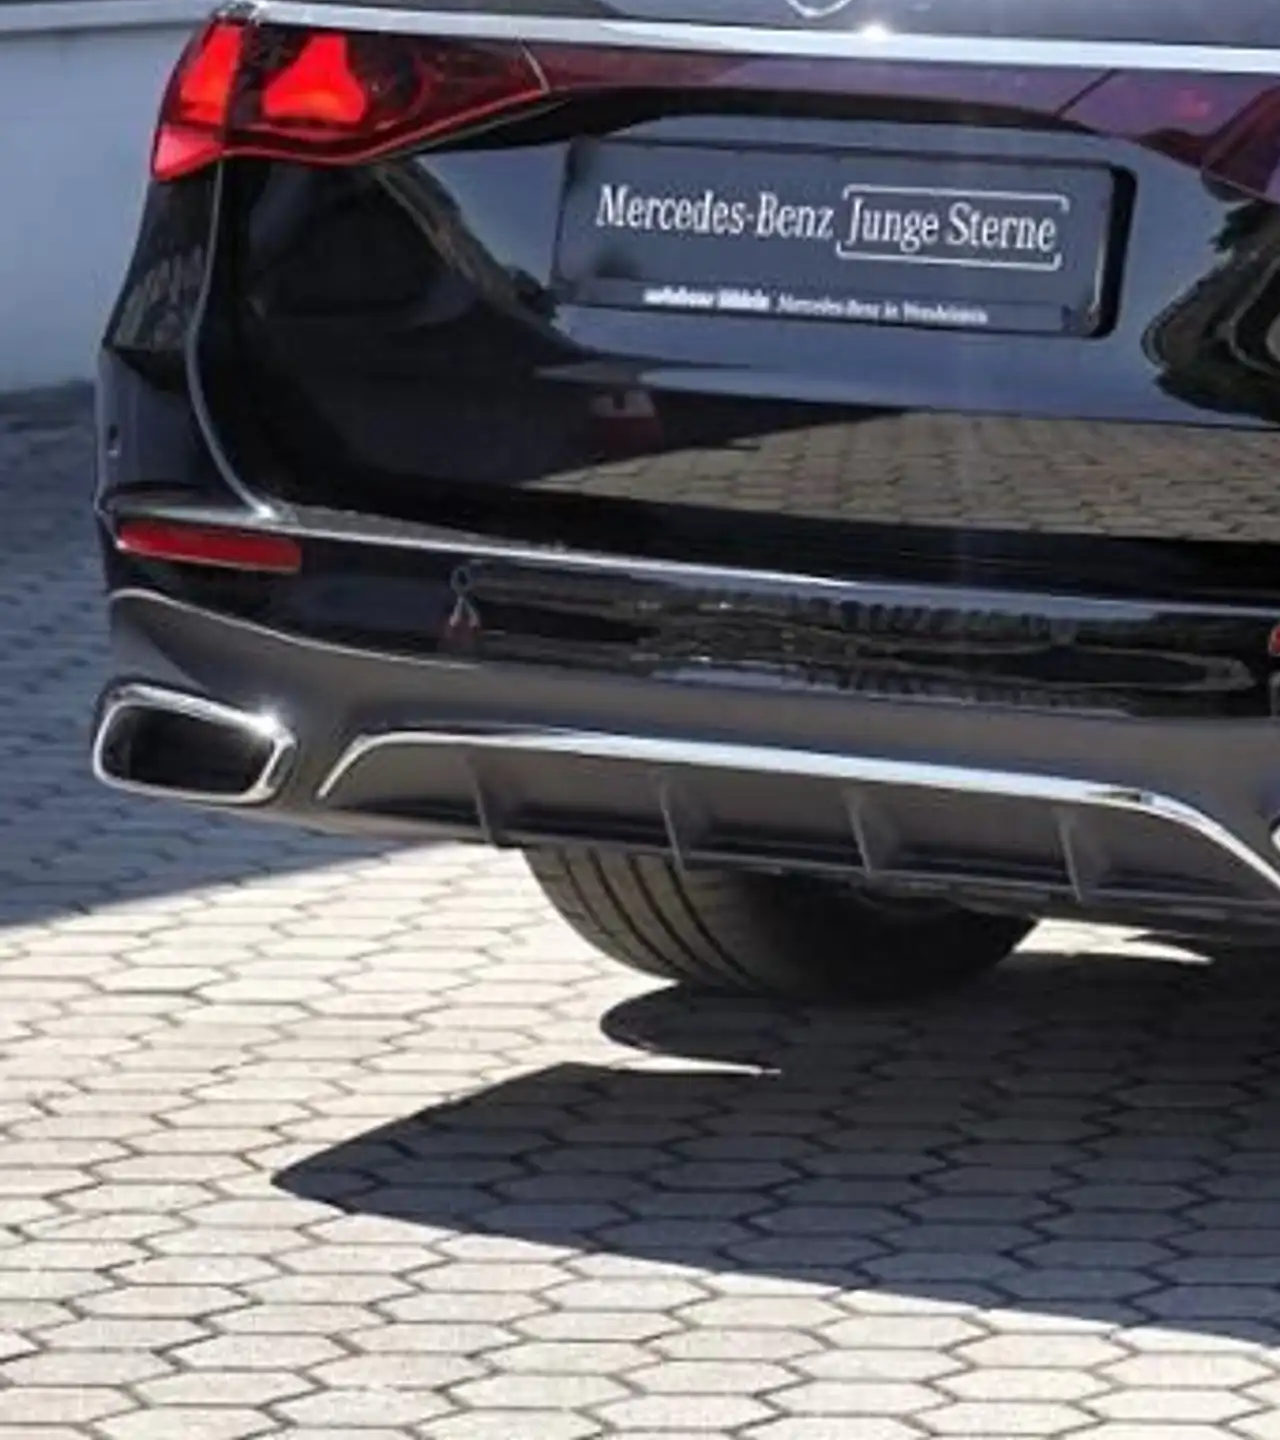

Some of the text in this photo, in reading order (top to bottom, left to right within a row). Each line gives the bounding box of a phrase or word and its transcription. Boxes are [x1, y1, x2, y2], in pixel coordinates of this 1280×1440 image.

[596, 184, 1057, 252] Mercedes-Benz Junge Sterne
